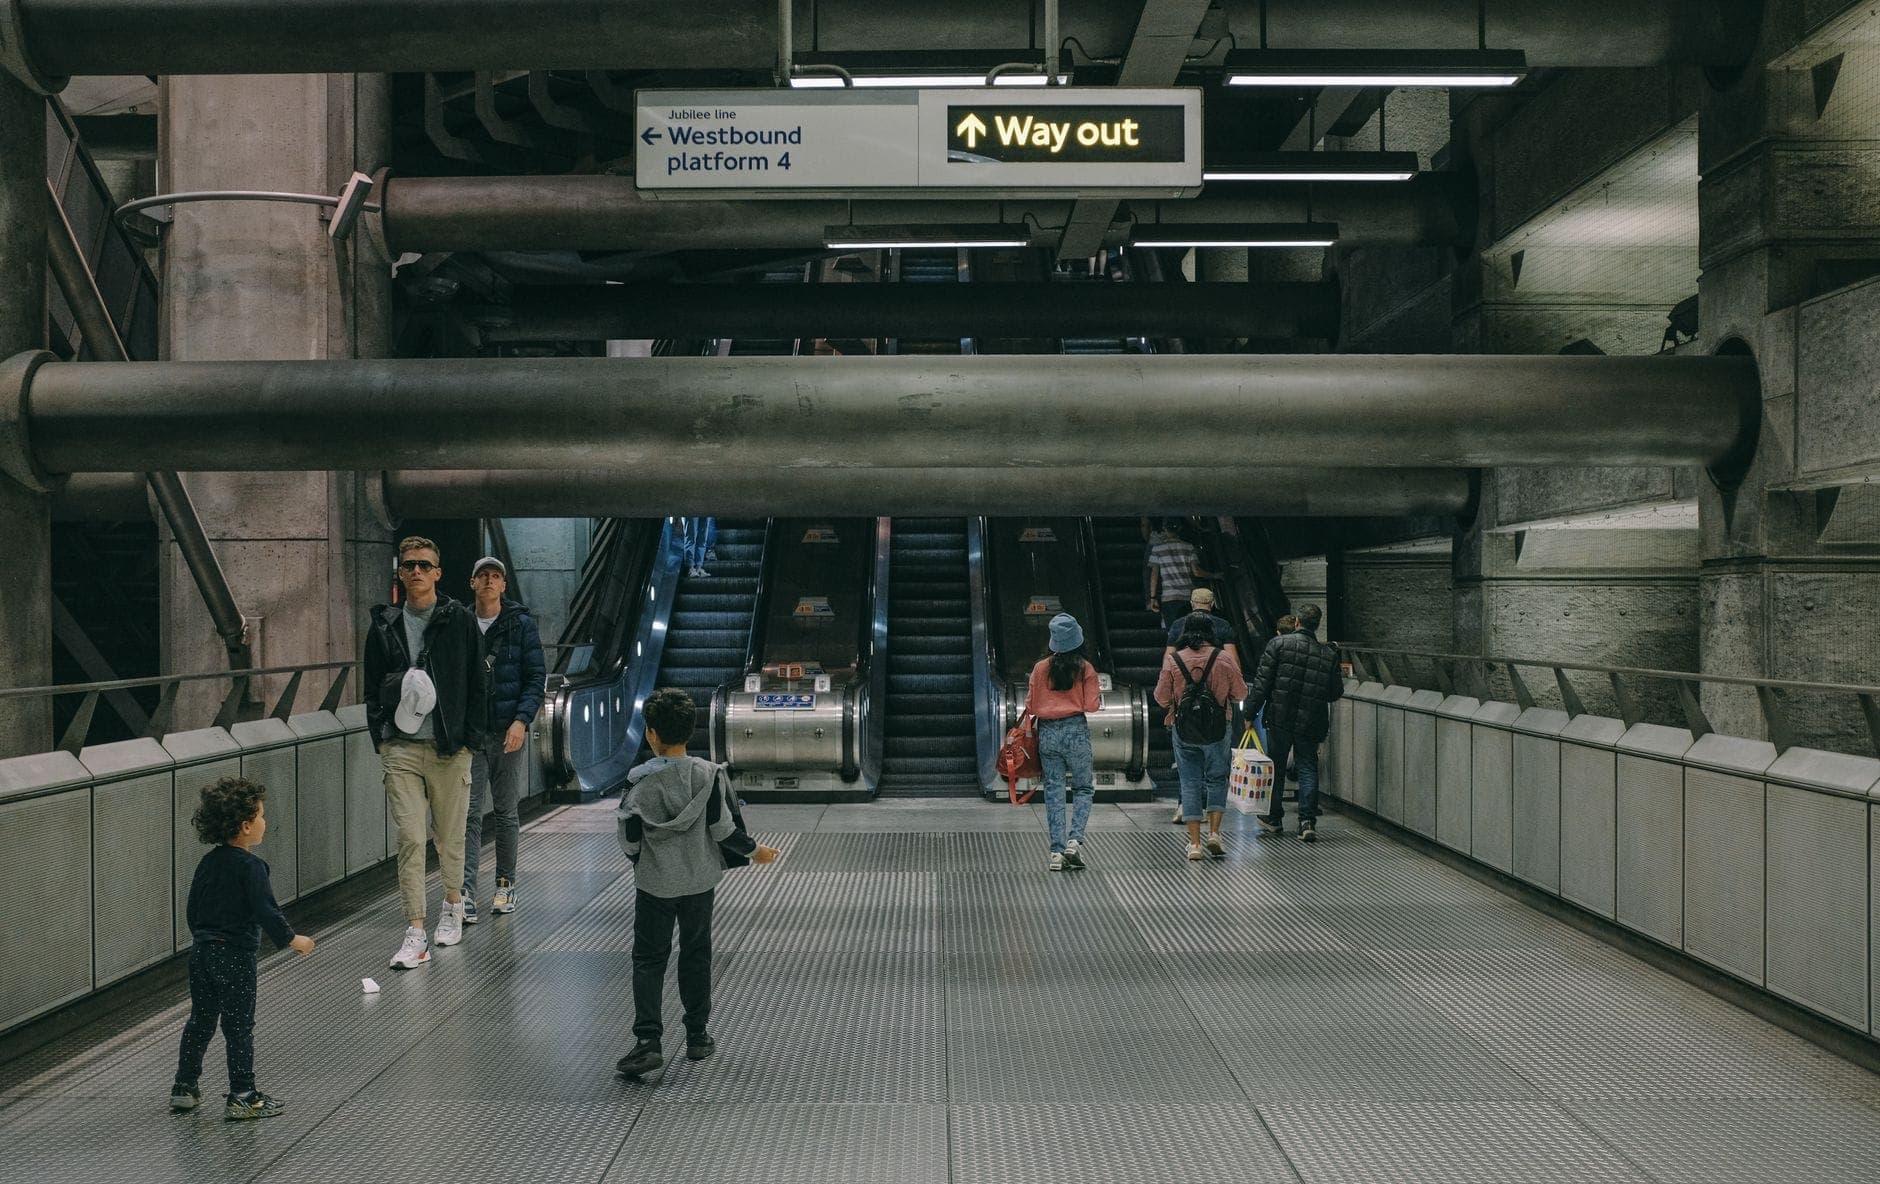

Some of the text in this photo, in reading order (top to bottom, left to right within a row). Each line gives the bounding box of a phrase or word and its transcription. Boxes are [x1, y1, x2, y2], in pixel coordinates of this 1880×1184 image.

[668, 109, 737, 120] Jubilee line
[667, 126, 802, 145] Westbound
[994, 115, 1139, 153] Way out
[667, 151, 792, 176] platform 4
